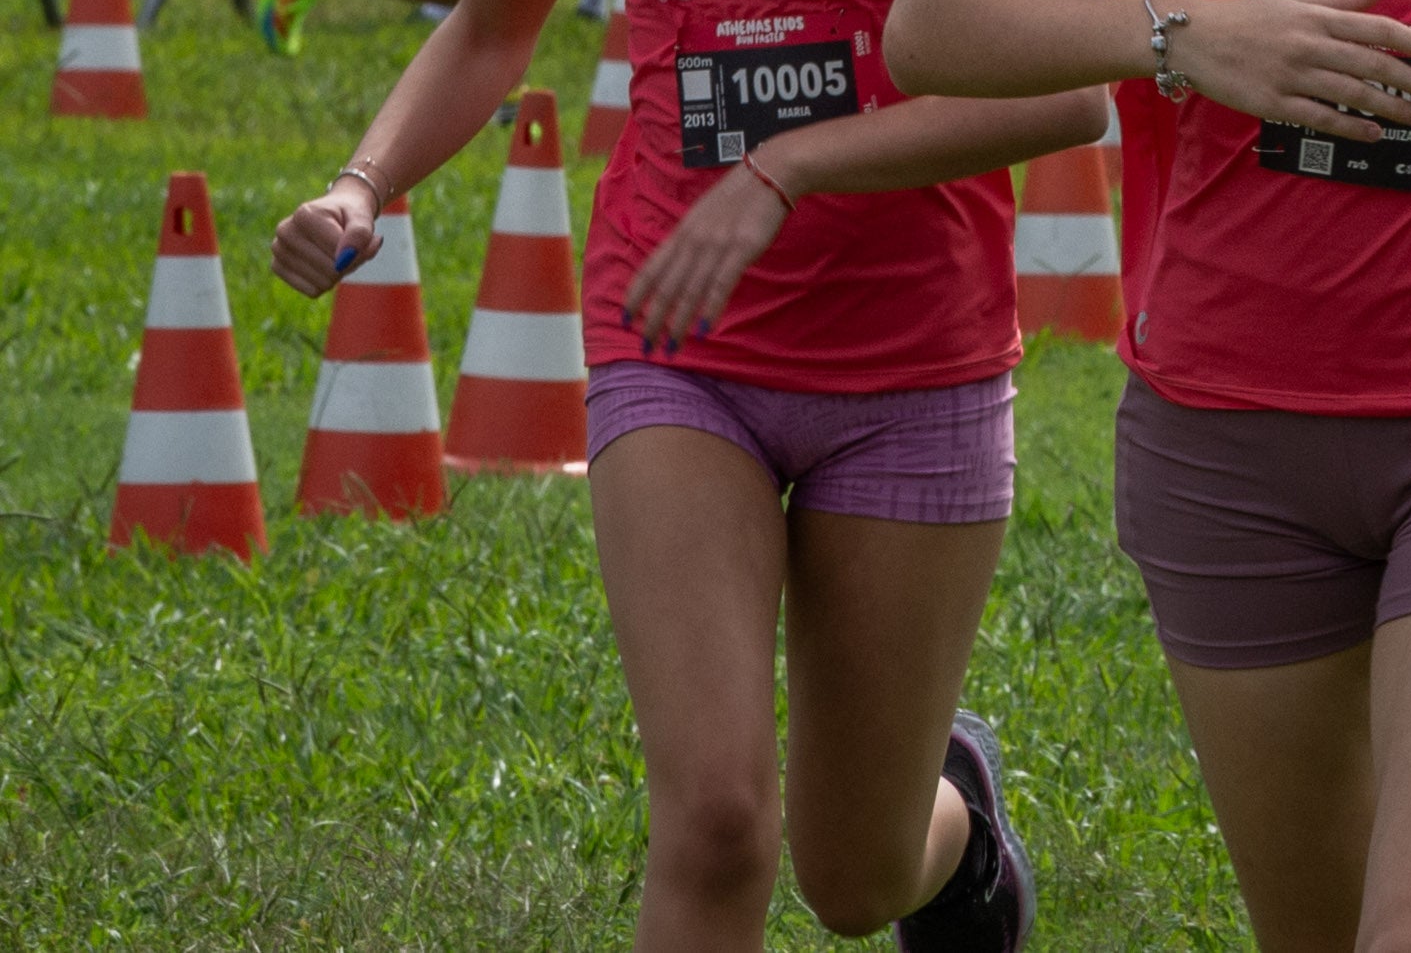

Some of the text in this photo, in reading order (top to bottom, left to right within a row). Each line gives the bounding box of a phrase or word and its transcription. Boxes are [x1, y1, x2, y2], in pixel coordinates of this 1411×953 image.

[716, 16, 804, 37] ATHENAS KIDS
[677, 57, 713, 70] 500m
[732, 60, 847, 105] 10005
[684, 112, 715, 128] 2013
[777, 106, 812, 119] MARIA
